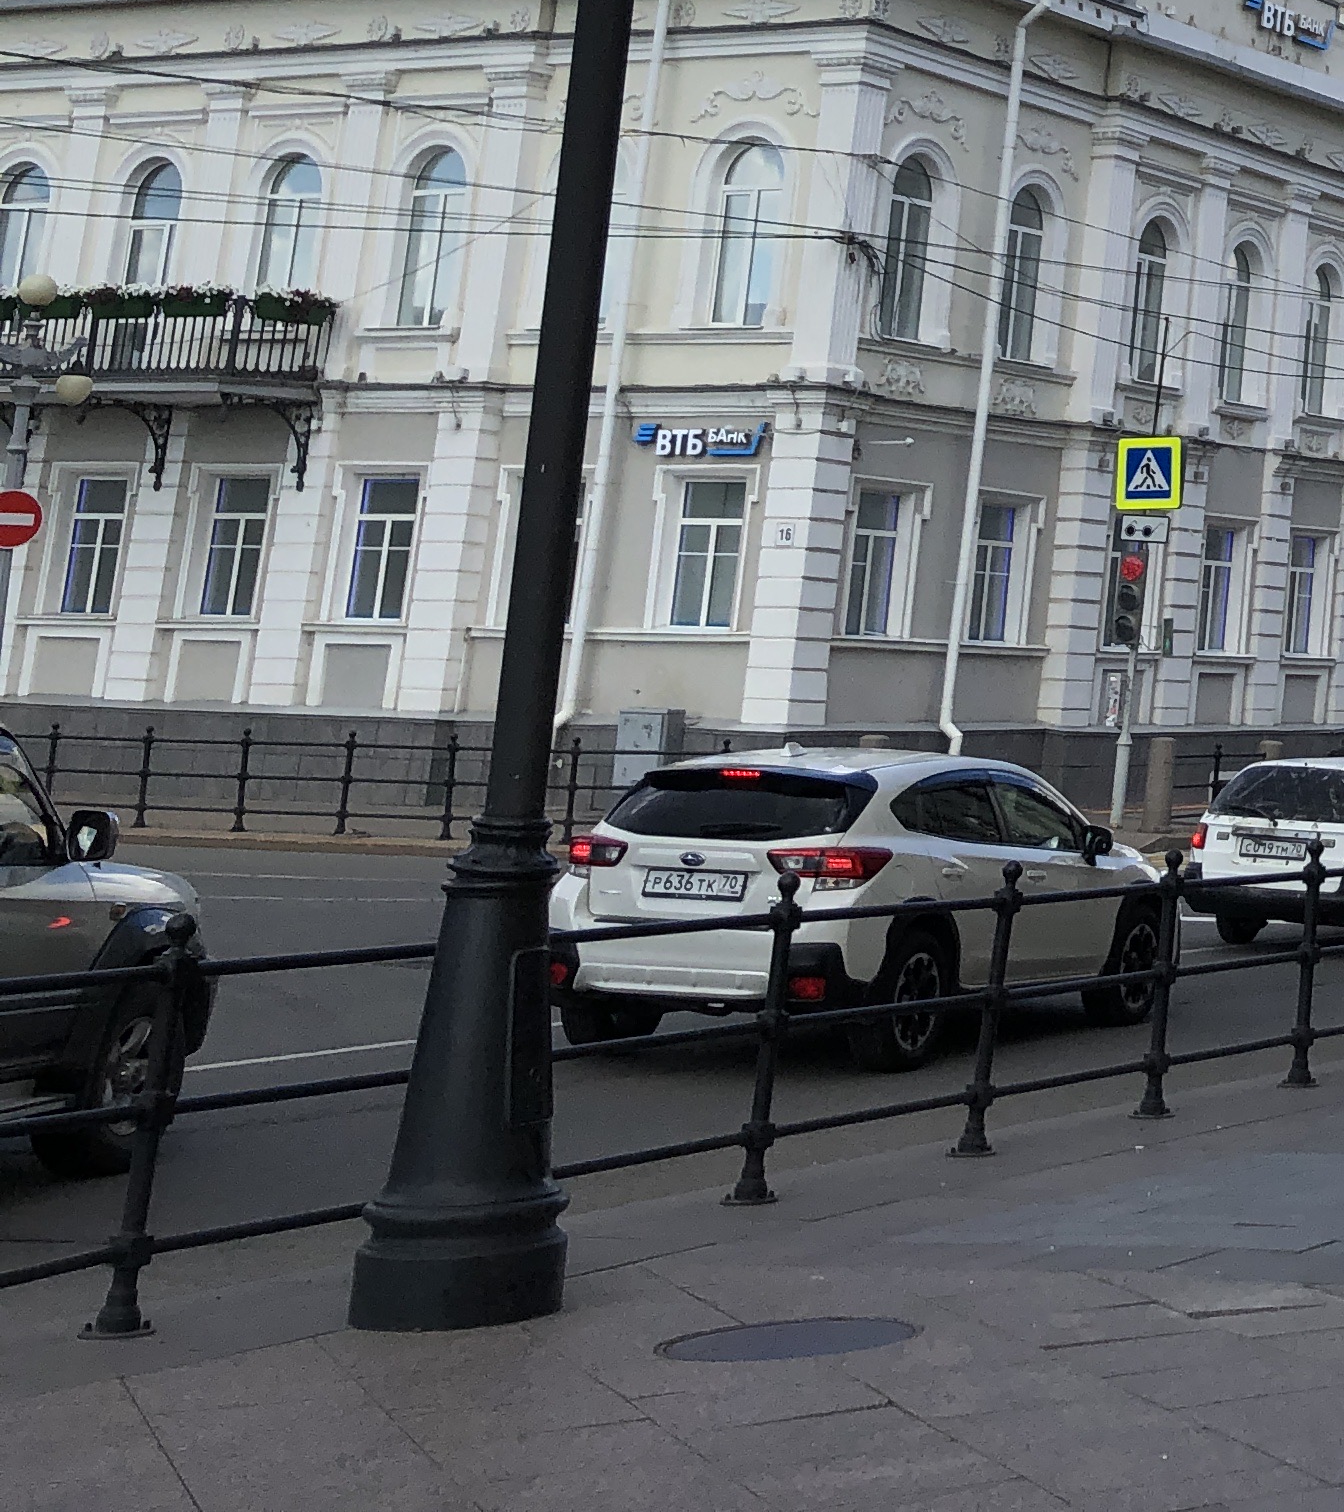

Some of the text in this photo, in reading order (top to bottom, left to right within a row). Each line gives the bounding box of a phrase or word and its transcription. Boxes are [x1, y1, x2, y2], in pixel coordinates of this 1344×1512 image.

[1261, 0, 1325, 37] ВТБ БАНК
[656, 428, 747, 456] ВТБ БАНК
[778, 527, 792, 541] 16
[722, 875, 739, 890] 70
